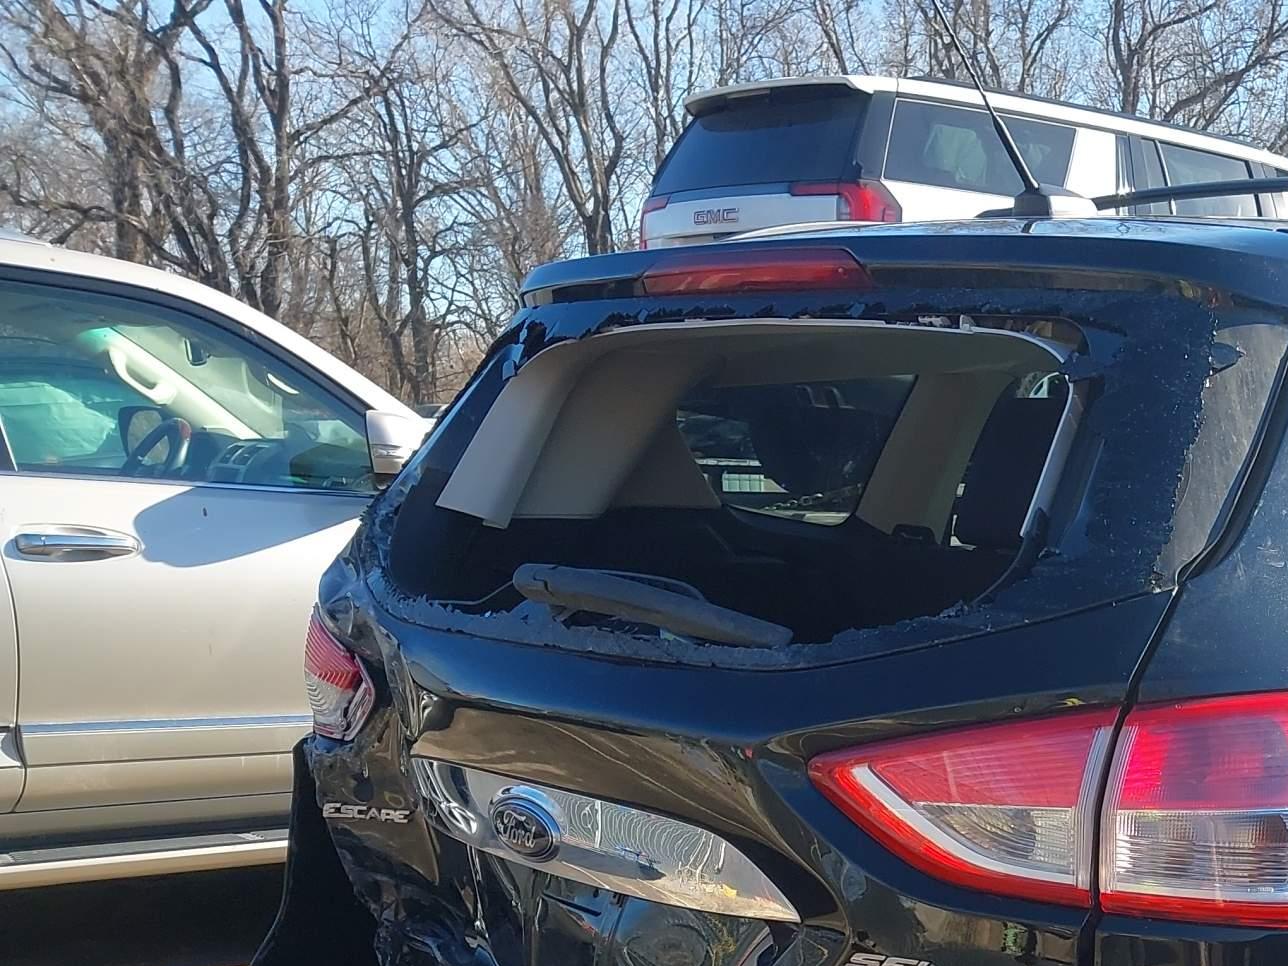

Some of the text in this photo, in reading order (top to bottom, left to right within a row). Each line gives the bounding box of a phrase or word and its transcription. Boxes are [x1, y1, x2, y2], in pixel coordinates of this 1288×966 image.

[693, 207, 739, 226] GMC
[322, 802, 411, 824] ESCAPE
[496, 809, 536, 849] Ford
